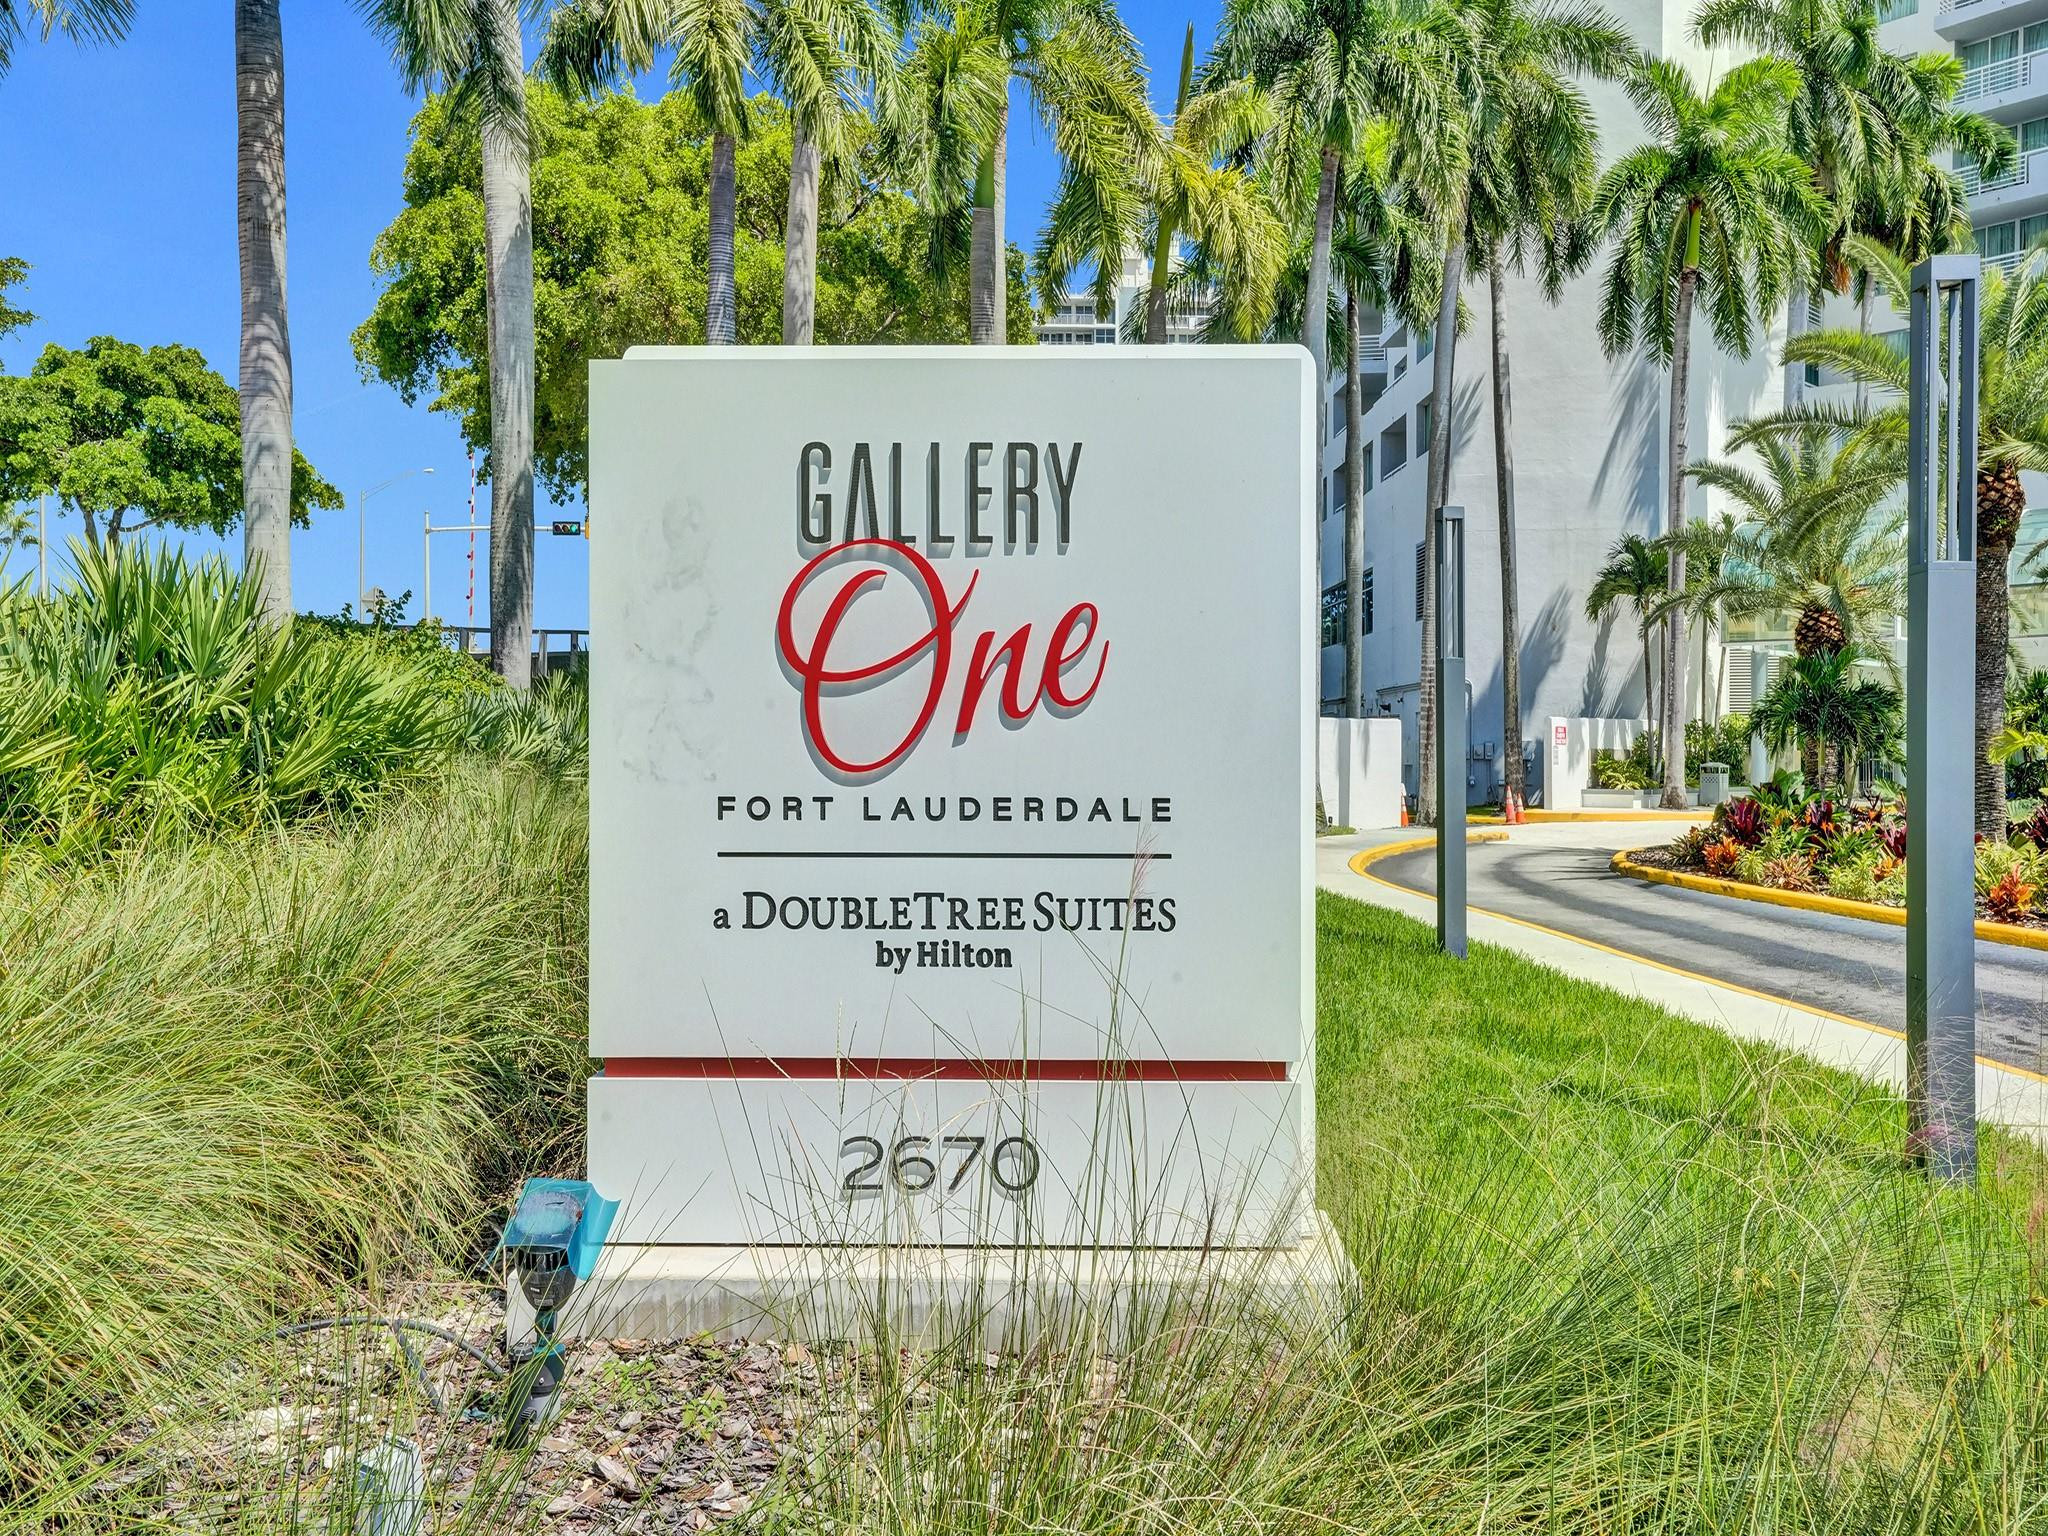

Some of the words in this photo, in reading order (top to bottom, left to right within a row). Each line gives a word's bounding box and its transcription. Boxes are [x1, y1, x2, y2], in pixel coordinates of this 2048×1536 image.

[800, 441, 1083, 544] GALLERY
[777, 537, 1110, 773] One
[717, 795, 834, 821] FORT
[863, 796, 1172, 823] LAUDERDALE
[713, 907, 732, 930] a
[875, 940, 911, 975] by
[916, 939, 1013, 968] Hilton
[842, 1135, 1040, 1192] 2670
